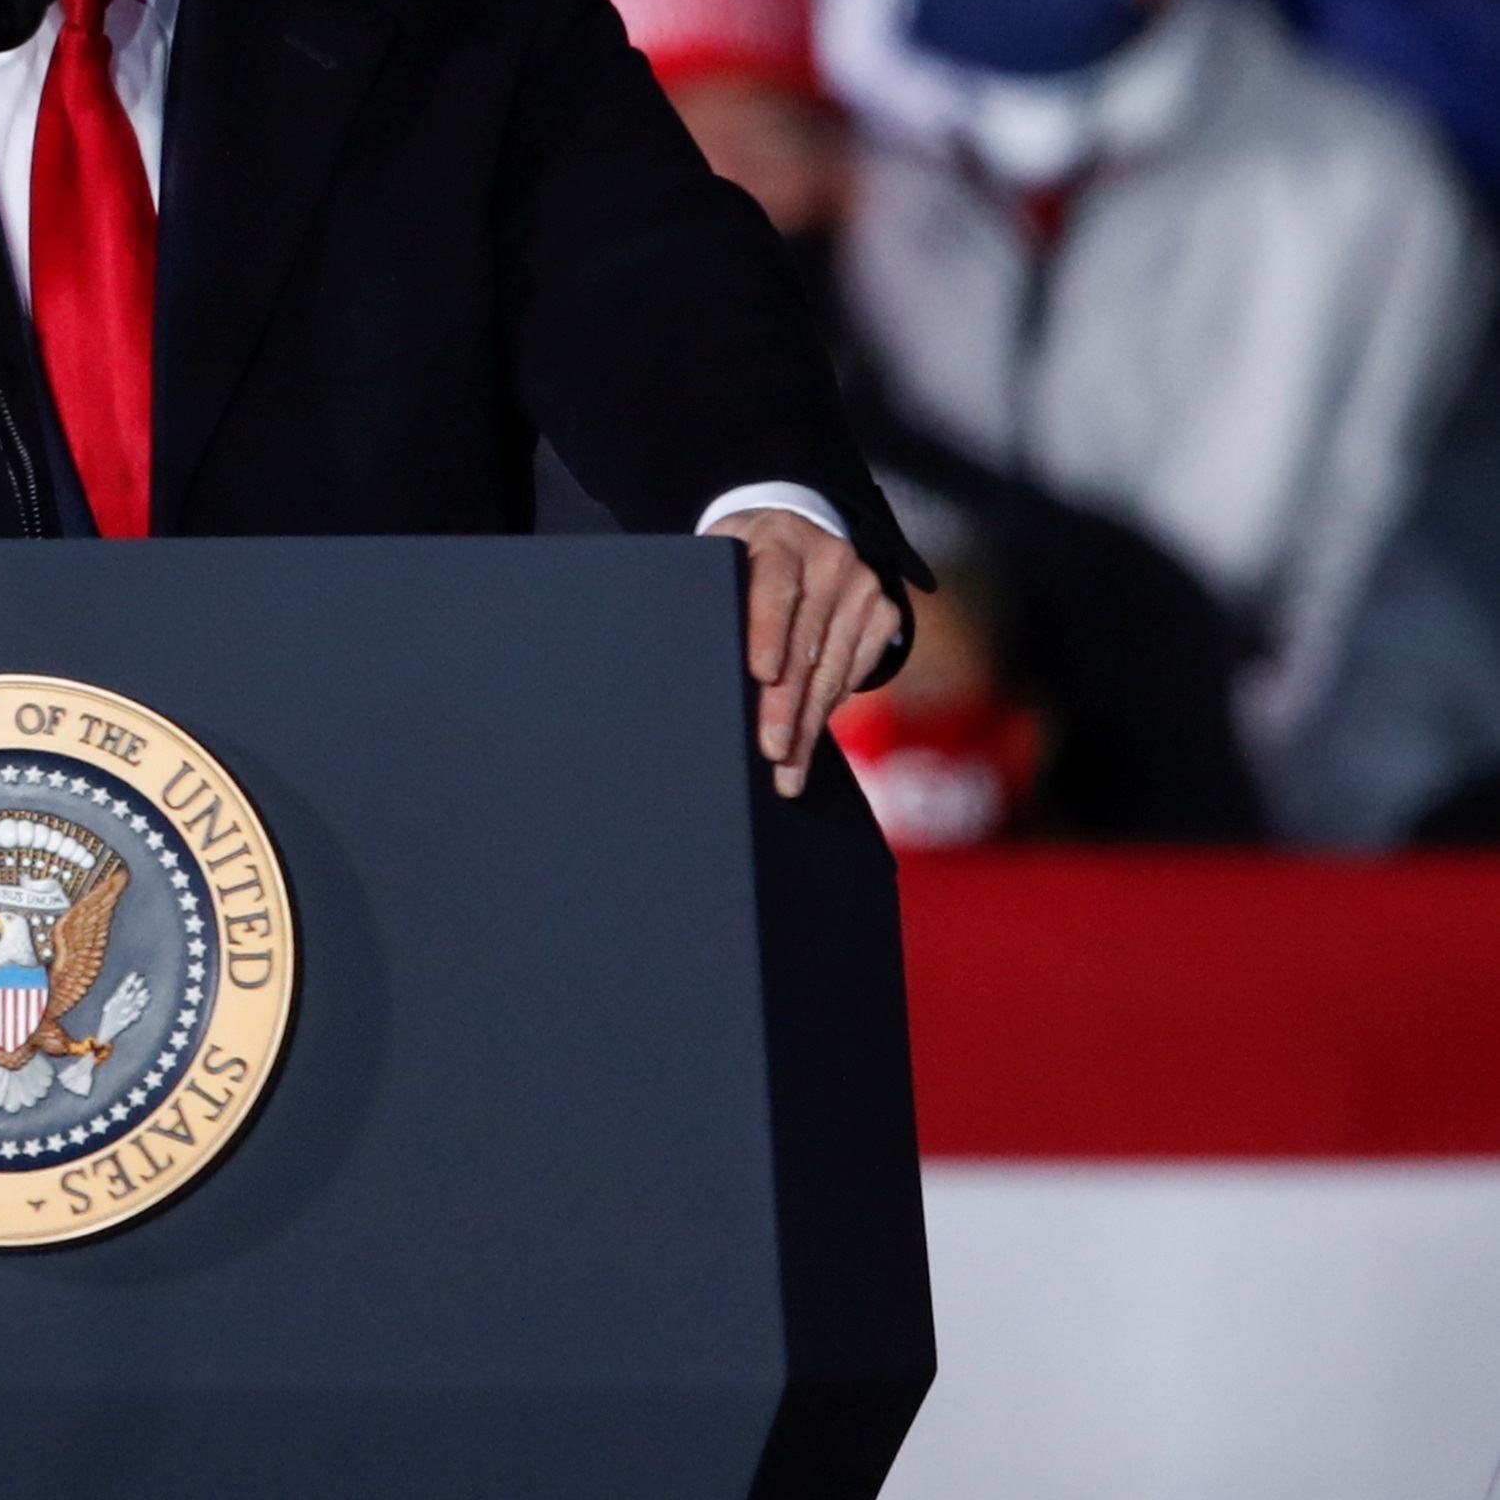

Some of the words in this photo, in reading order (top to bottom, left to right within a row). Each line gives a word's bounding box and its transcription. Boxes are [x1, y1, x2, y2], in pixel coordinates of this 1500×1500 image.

[15, 703, 66, 735] OF
[79, 713, 148, 767] THE
[161, 760, 274, 989] UNITED
[60, 1044, 248, 1215] STATES
